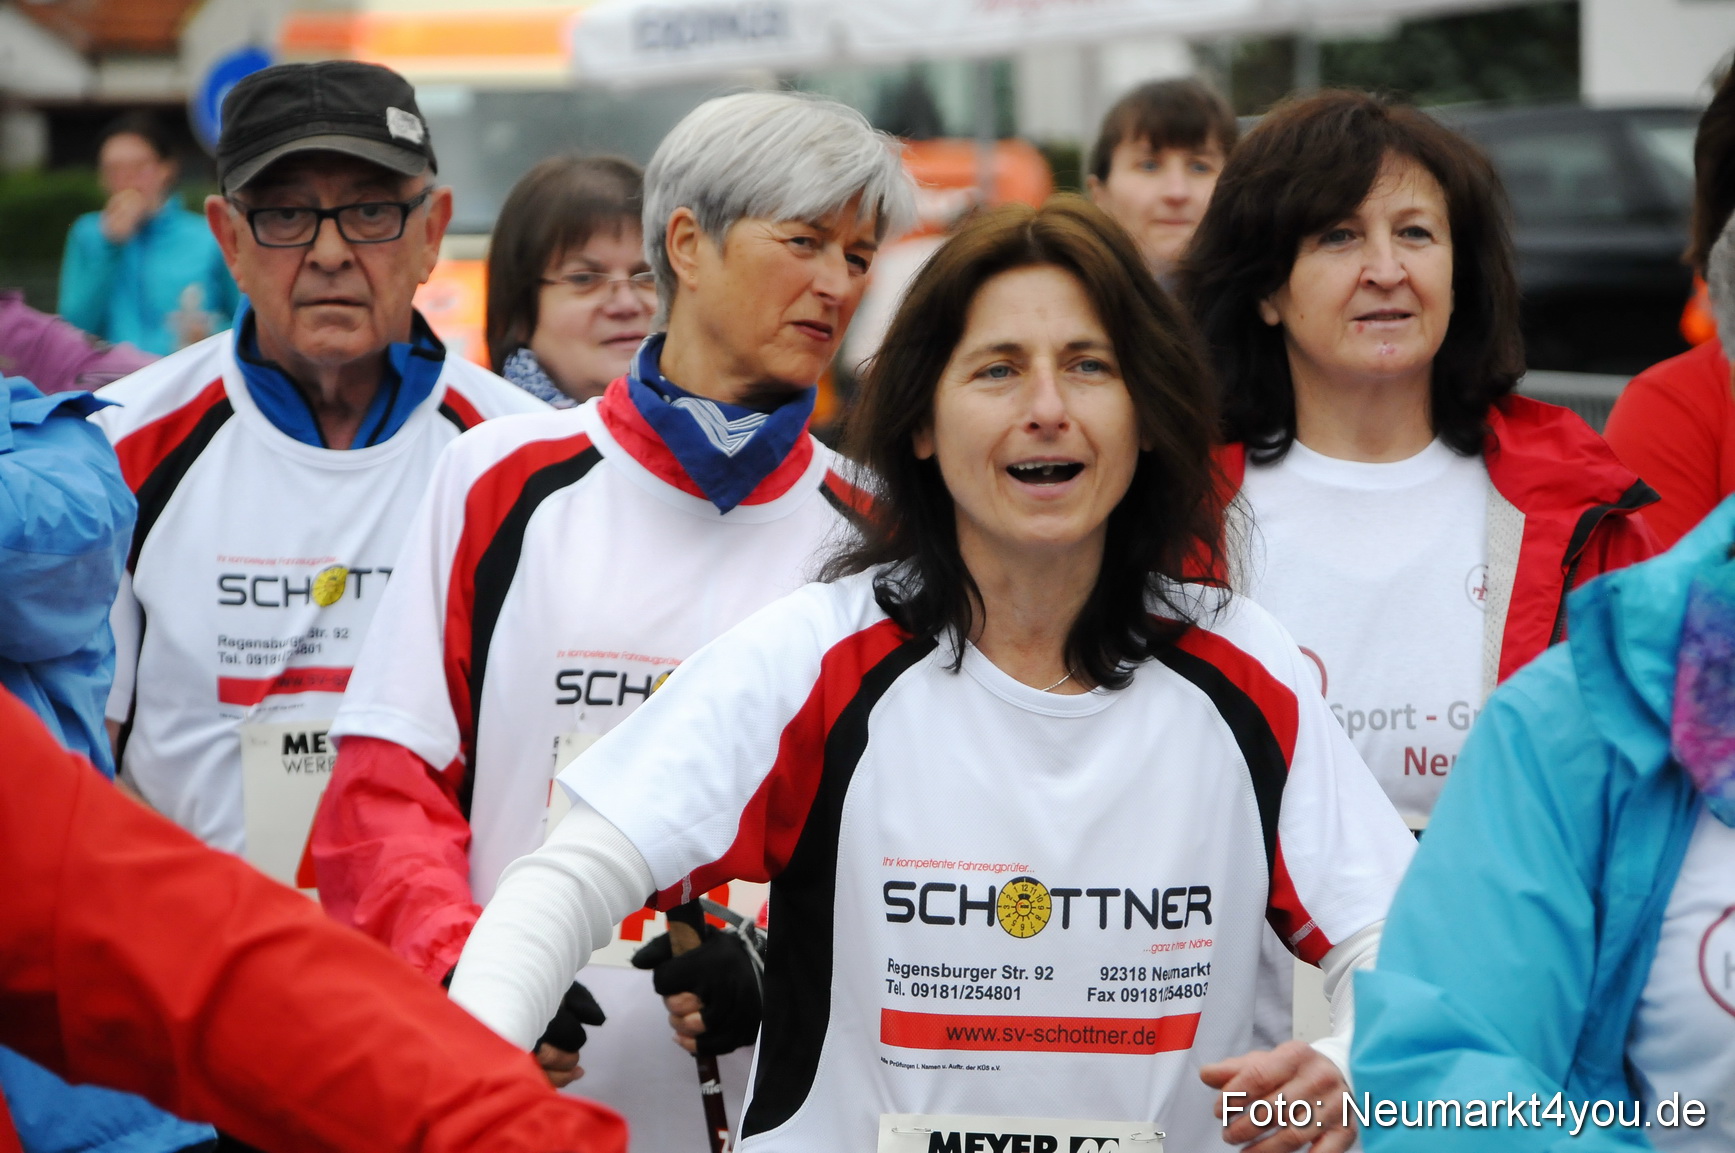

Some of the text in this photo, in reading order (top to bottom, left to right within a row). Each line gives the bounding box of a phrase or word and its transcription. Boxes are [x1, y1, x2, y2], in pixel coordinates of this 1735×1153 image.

[555, 667, 677, 706] SCH
[1330, 703, 1416, 740] Sport
[282, 731, 329, 755] ME
[883, 857, 895, 866] Ihr
[896, 857, 956, 869] kompetenter
[883, 875, 1213, 938] SCHOTTNER
[887, 958, 1054, 982] Regensburger Str. 92
[1100, 967, 1147, 981] 92318
[885, 979, 1021, 1000] Tel. 09181/254801
[1087, 987, 1116, 1002] Fax
[946, 1024, 1156, 1046] www.sv-schottner.de
